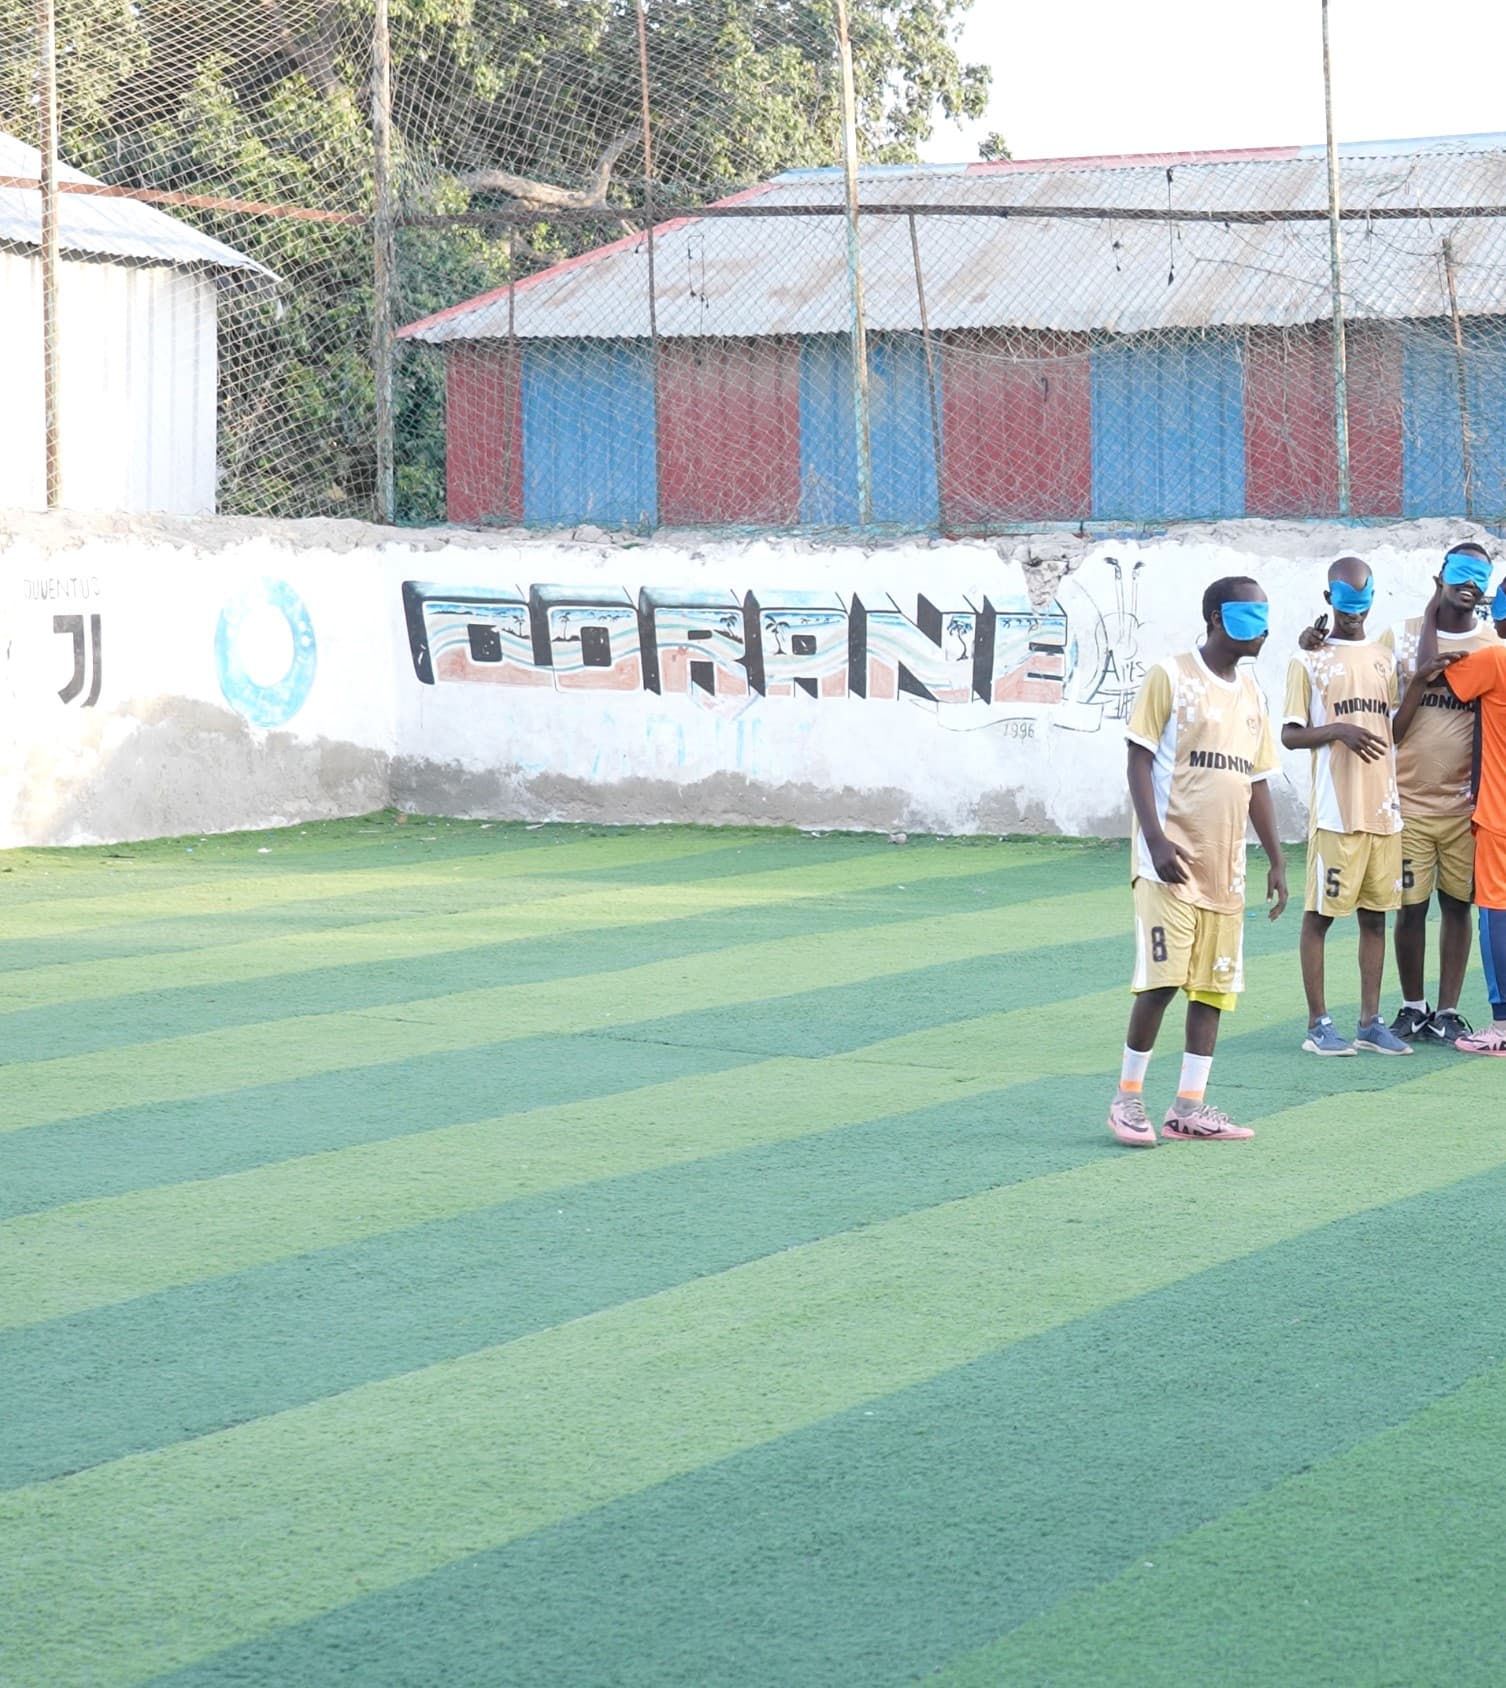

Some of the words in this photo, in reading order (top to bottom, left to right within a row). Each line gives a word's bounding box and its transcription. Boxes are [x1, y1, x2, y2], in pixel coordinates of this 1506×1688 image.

[24, 576, 102, 600] JUVENTUS
[1326, 868, 1341, 898] 5
[1151, 926, 1168, 962] 8
